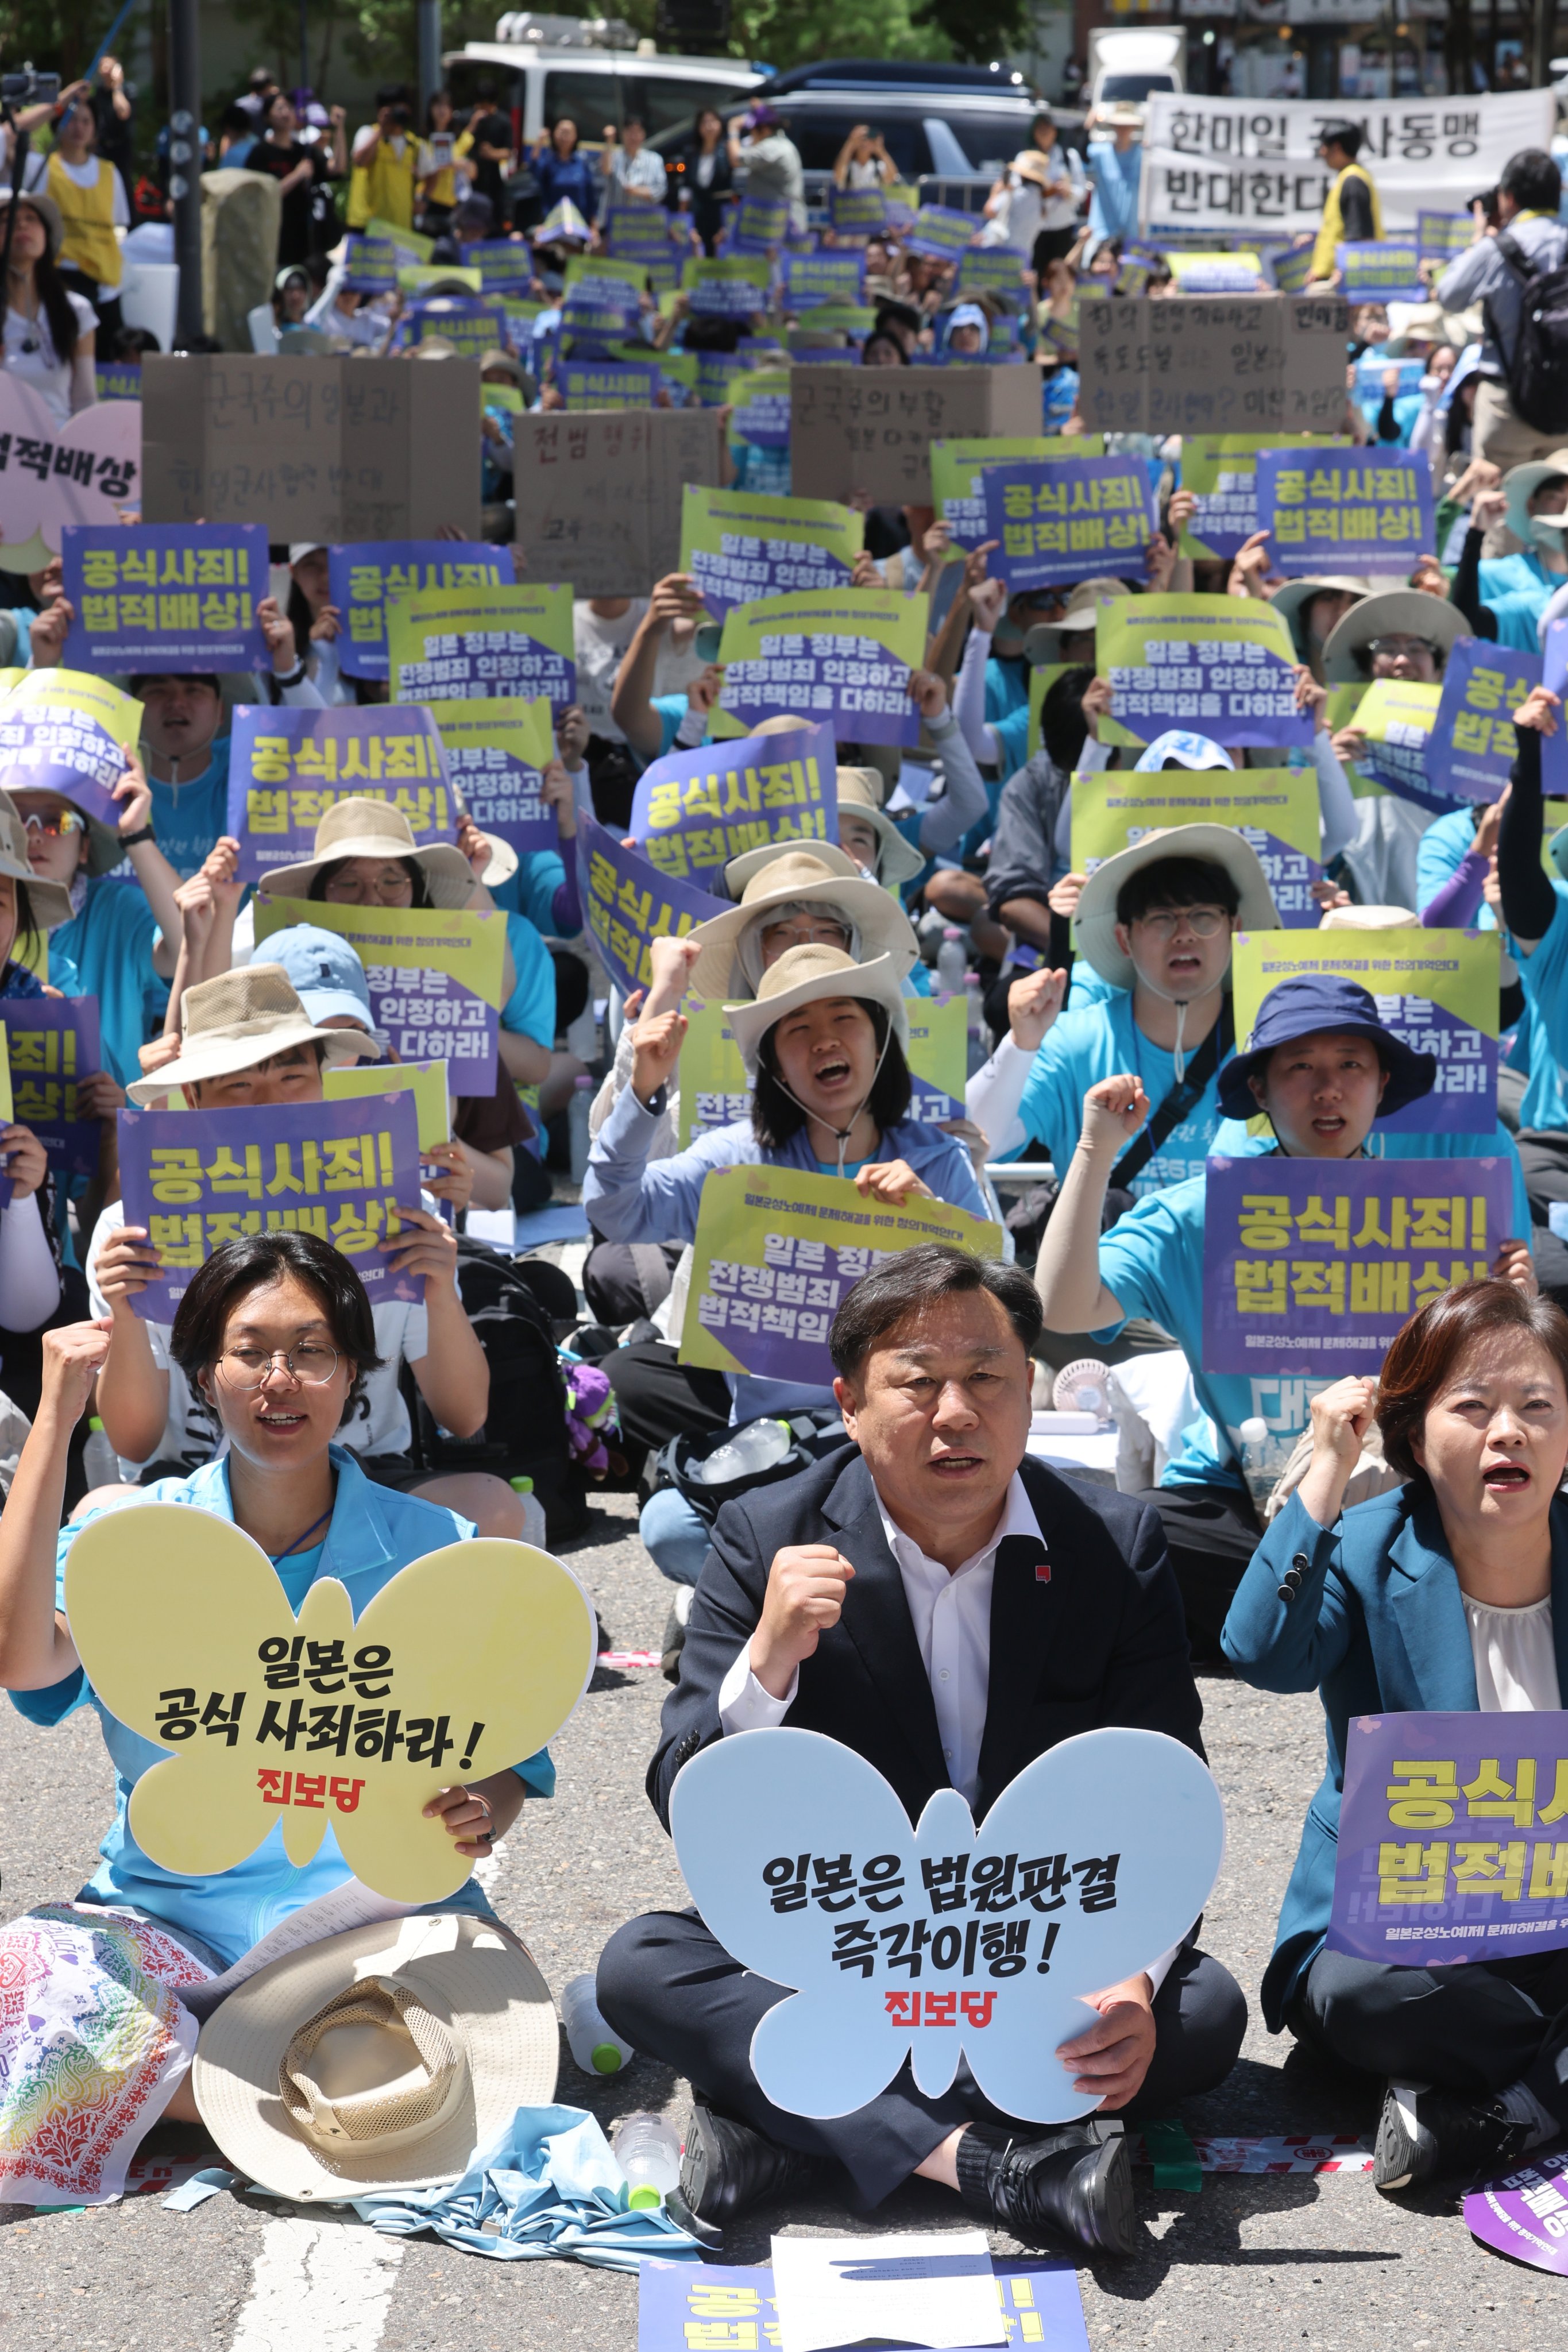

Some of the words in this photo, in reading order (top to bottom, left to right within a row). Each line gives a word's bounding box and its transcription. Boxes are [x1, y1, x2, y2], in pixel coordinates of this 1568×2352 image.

[1171, 110, 1287, 158] 한미일
[1003, 476, 1143, 518] 공식사죄!
[1274, 468, 1417, 504] 공식사죄!
[1003, 513, 1150, 557] 법적배상!
[1273, 506, 1422, 543] 법적배상!
[82, 548, 249, 588] 공식사죄!
[81, 592, 253, 632] 법적배상!
[423, 633, 458, 659] 일본
[464, 629, 530, 654] 정부는
[760, 633, 804, 658] 일본
[809, 634, 880, 660] 정부는
[1144, 640, 1190, 665] 일본
[1197, 640, 1266, 665] 정부는
[476, 654, 565, 679] 인정하고
[723, 658, 816, 687] 전쟁범죄
[822, 661, 910, 690] 인정하고
[1109, 666, 1203, 690] 전쟁범죄
[1210, 667, 1299, 691] 인정하고
[840, 688, 913, 717] 다하라!
[49, 746, 120, 790] 다하라
[251, 734, 441, 783] 공식사죄!
[453, 773, 542, 795] 인정하고
[648, 756, 821, 829] 공식사죄!
[247, 786, 449, 834] 법적상!
[473, 799, 549, 822] 다하라!
[590, 850, 705, 939] 공식사
[366, 964, 449, 994] 정부는
[379, 998, 486, 1026] 인정하고
[1377, 994, 1434, 1025] 부는
[400, 1031, 489, 1059] 다하라!
[148, 1130, 395, 1205] 공식사죄!
[744, 1192, 818, 1217] 일본군성노예제
[818, 1206, 872, 1227] 문제해결을
[872, 1215, 895, 1228] 위한
[896, 1218, 964, 1242] 정의기억연대
[1237, 1194, 1488, 1251] 공식사죄!
[763, 1232, 827, 1272] 일본
[708, 1258, 840, 1309] 전쟁범죄
[698, 1293, 831, 1344] 법적책임
[1245, 1334, 1321, 1350] 일본군성노예제
[1322, 1335, 1377, 1350] 문제해결을
[257, 1635, 394, 1700] 일본은
[155, 1687, 248, 1747] 공식
[255, 1698, 486, 1771] 사죄하라!
[256, 1768, 366, 1814] 진보당
[1385, 1758, 1568, 1830] 공식
[762, 1853, 905, 1914] 일본은
[921, 1852, 1122, 1914] 법원판결
[831, 1918, 1061, 1979] 즉각이행!
[1385, 1925, 1485, 1941] 일본군성노예제
[1486, 1919, 1558, 1938] 문제해결을
[883, 1990, 998, 2029] 진보당
